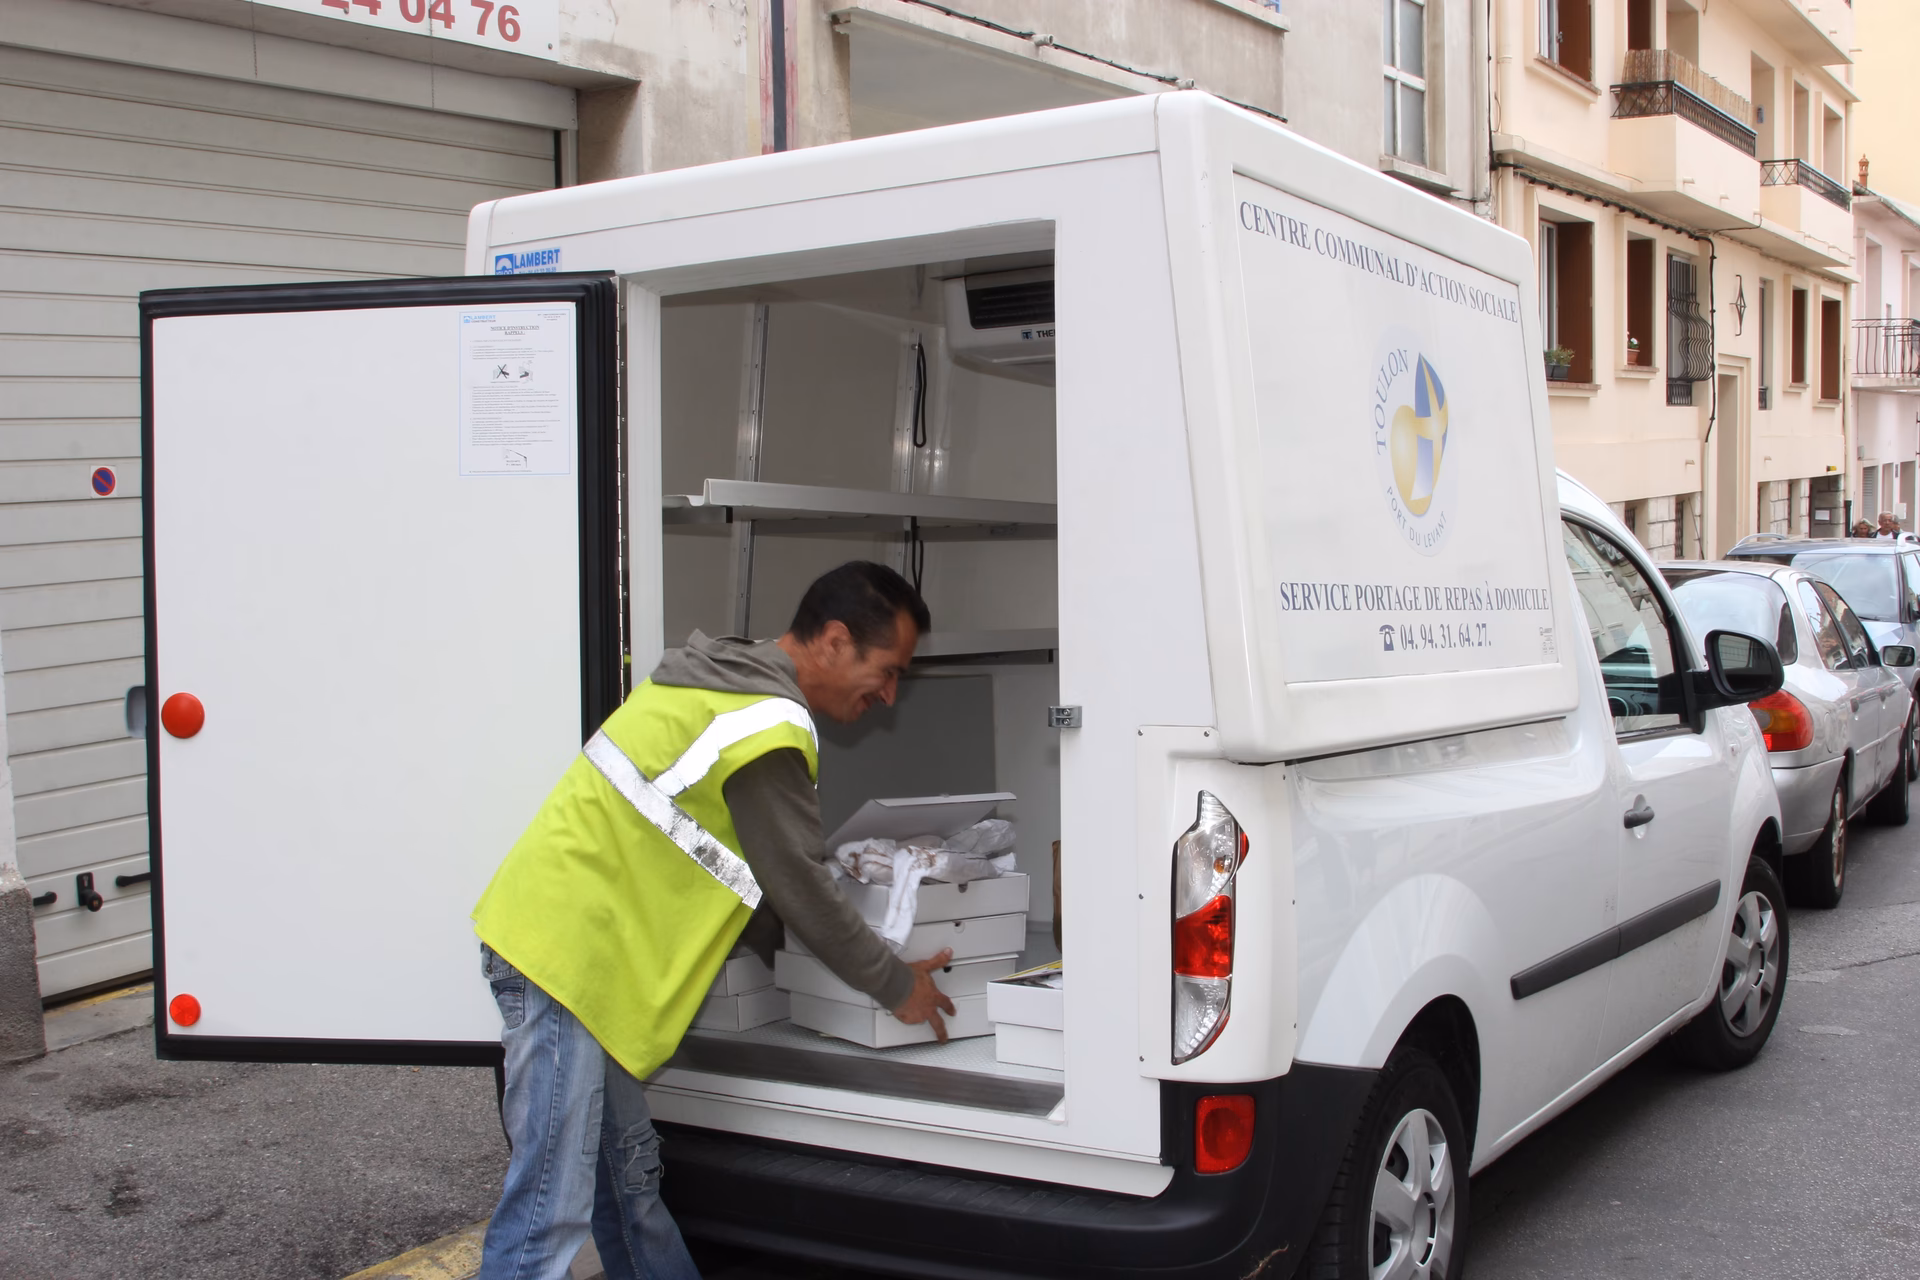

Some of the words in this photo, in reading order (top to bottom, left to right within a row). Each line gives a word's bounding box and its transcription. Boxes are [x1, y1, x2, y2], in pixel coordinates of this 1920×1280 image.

[470, 0, 521, 43] 76
[514, 248, 560, 269] LAMBERT
[1240, 201, 1311, 251] CENTRE
[1314, 228, 1404, 284] COMMUNAL
[1405, 261, 1468, 306] D'ACTION
[1469, 286, 1518, 323] SOCIALE
[1036, 329, 1055, 338] THE
[1374, 348, 1409, 455] TOULON
[1387, 486, 1406, 530] PORT
[1410, 526, 1420, 546] DU
[1424, 511, 1446, 548] LEVANT
[1280, 582, 1352, 611] SERVICE
[1354, 584, 1422, 611] PORTAGE
[1424, 586, 1443, 611] DE
[1444, 586, 1483, 611] REPAS
[1495, 587, 1549, 611] DOMICILE
